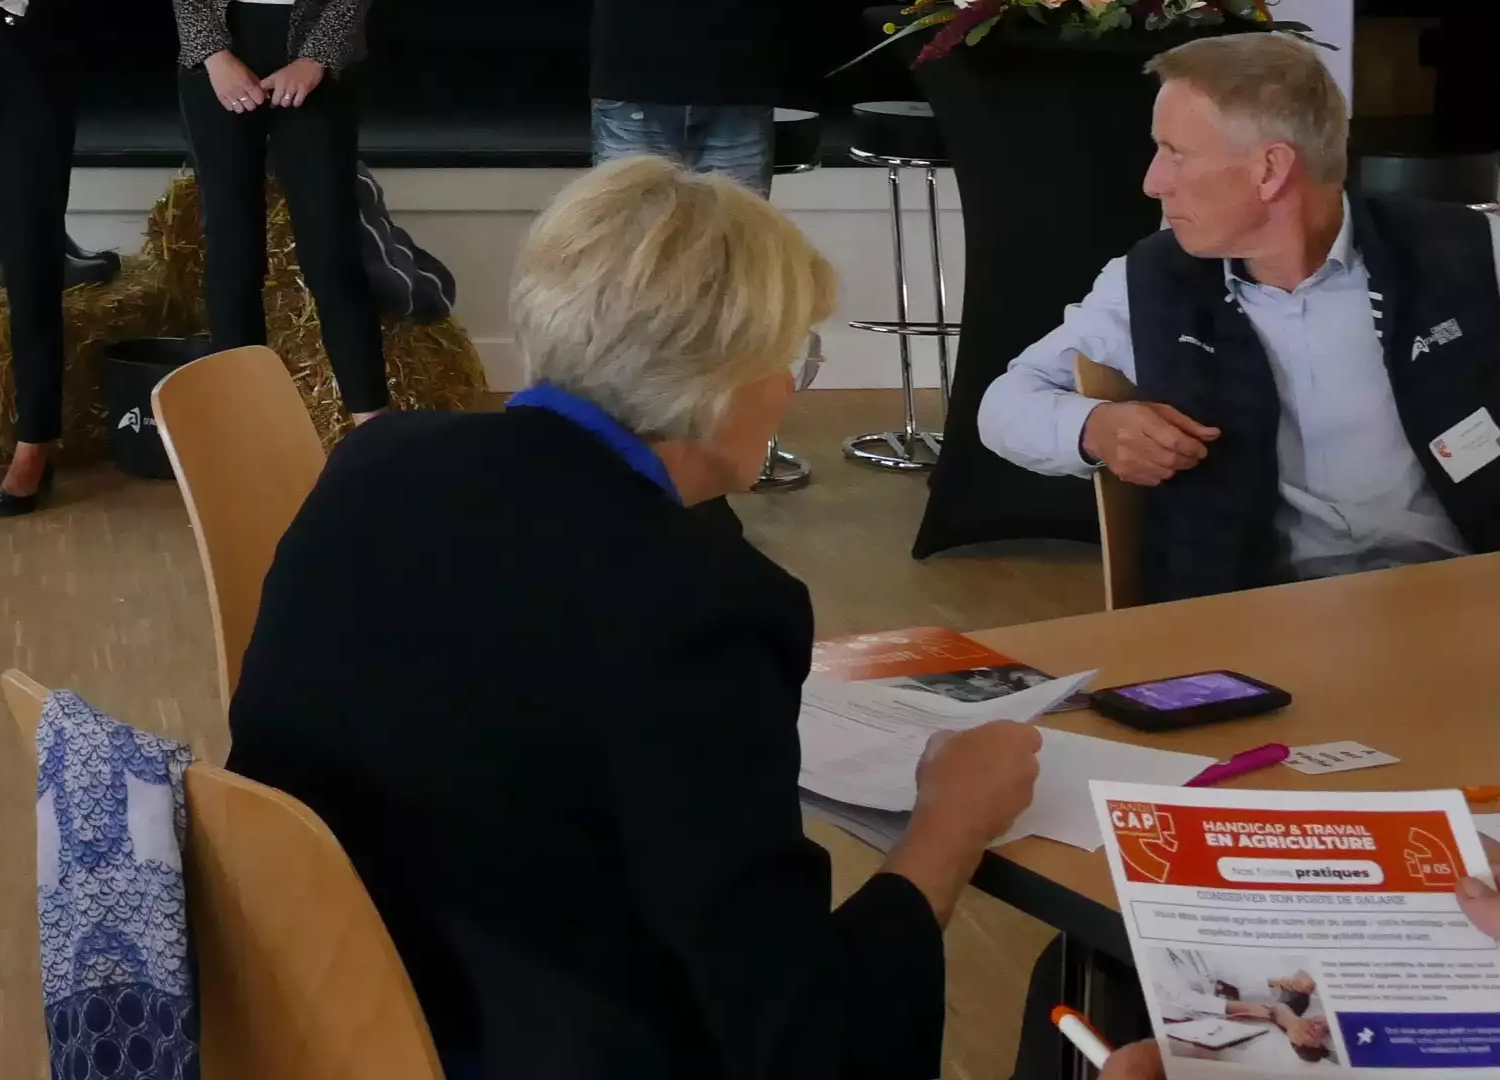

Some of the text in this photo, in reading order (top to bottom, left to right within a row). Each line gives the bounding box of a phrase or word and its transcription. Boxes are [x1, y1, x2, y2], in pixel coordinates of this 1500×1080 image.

[1111, 810, 1154, 829] CAP
[1202, 820, 1372, 836] HANDICAP & TRAVAIL
[1204, 832, 1377, 851] EN AGRICULTURE
[1295, 866, 1370, 880] pratiques
[1337, 895, 1353, 905] DE
